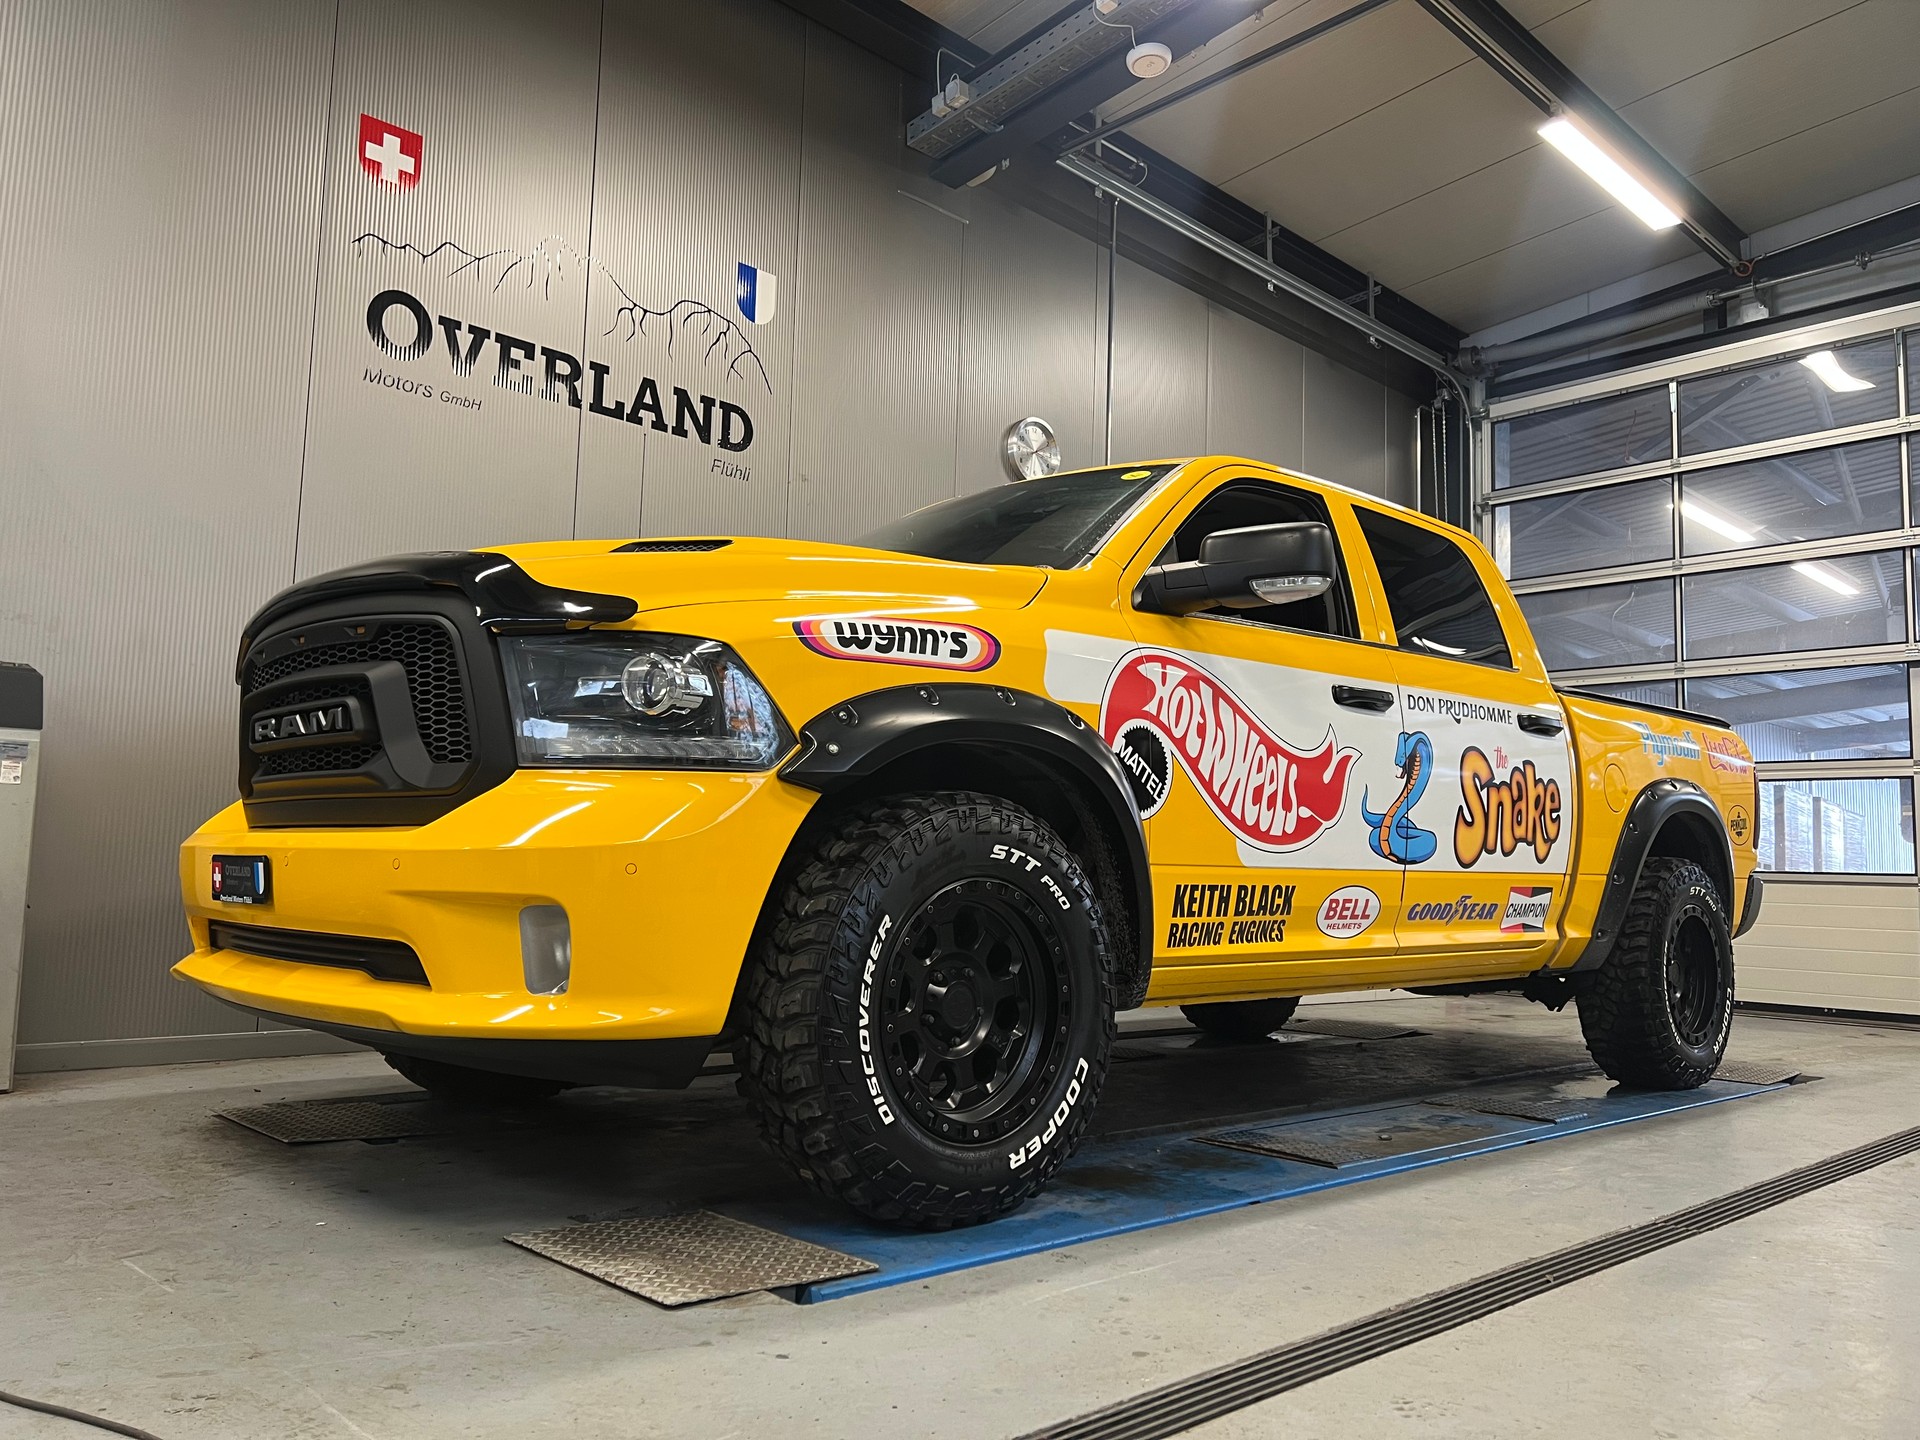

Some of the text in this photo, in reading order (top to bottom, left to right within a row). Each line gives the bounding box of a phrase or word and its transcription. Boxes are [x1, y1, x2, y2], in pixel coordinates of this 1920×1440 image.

[363, 366, 482, 411] Motors GmbH
[366, 289, 754, 453] OVERLAND
[711, 458, 751, 482] Flühli
[255, 706, 342, 741] RAM
[1407, 694, 1513, 725] DON PRUDHOMME
[1493, 746, 1508, 770] the
[1632, 721, 1700, 767] Plymouth
[1115, 741, 1165, 802] MATTEL
[1453, 745, 1562, 870] Snake
[990, 844, 1071, 911] STT PRO
[1171, 884, 1296, 919] KEITH BLACK
[1323, 898, 1371, 921] BELL
[1505, 902, 1549, 919] CHAMPION
[1689, 886, 1717, 912] STT PRO
[1166, 919, 1287, 949] RACING ENGINES
[1325, 922, 1362, 931] HELMETS
[858, 913, 896, 1126] DISCOVERER
[1712, 987, 1733, 1055] COOPER
[1008, 1056, 1090, 1171] COOPER
